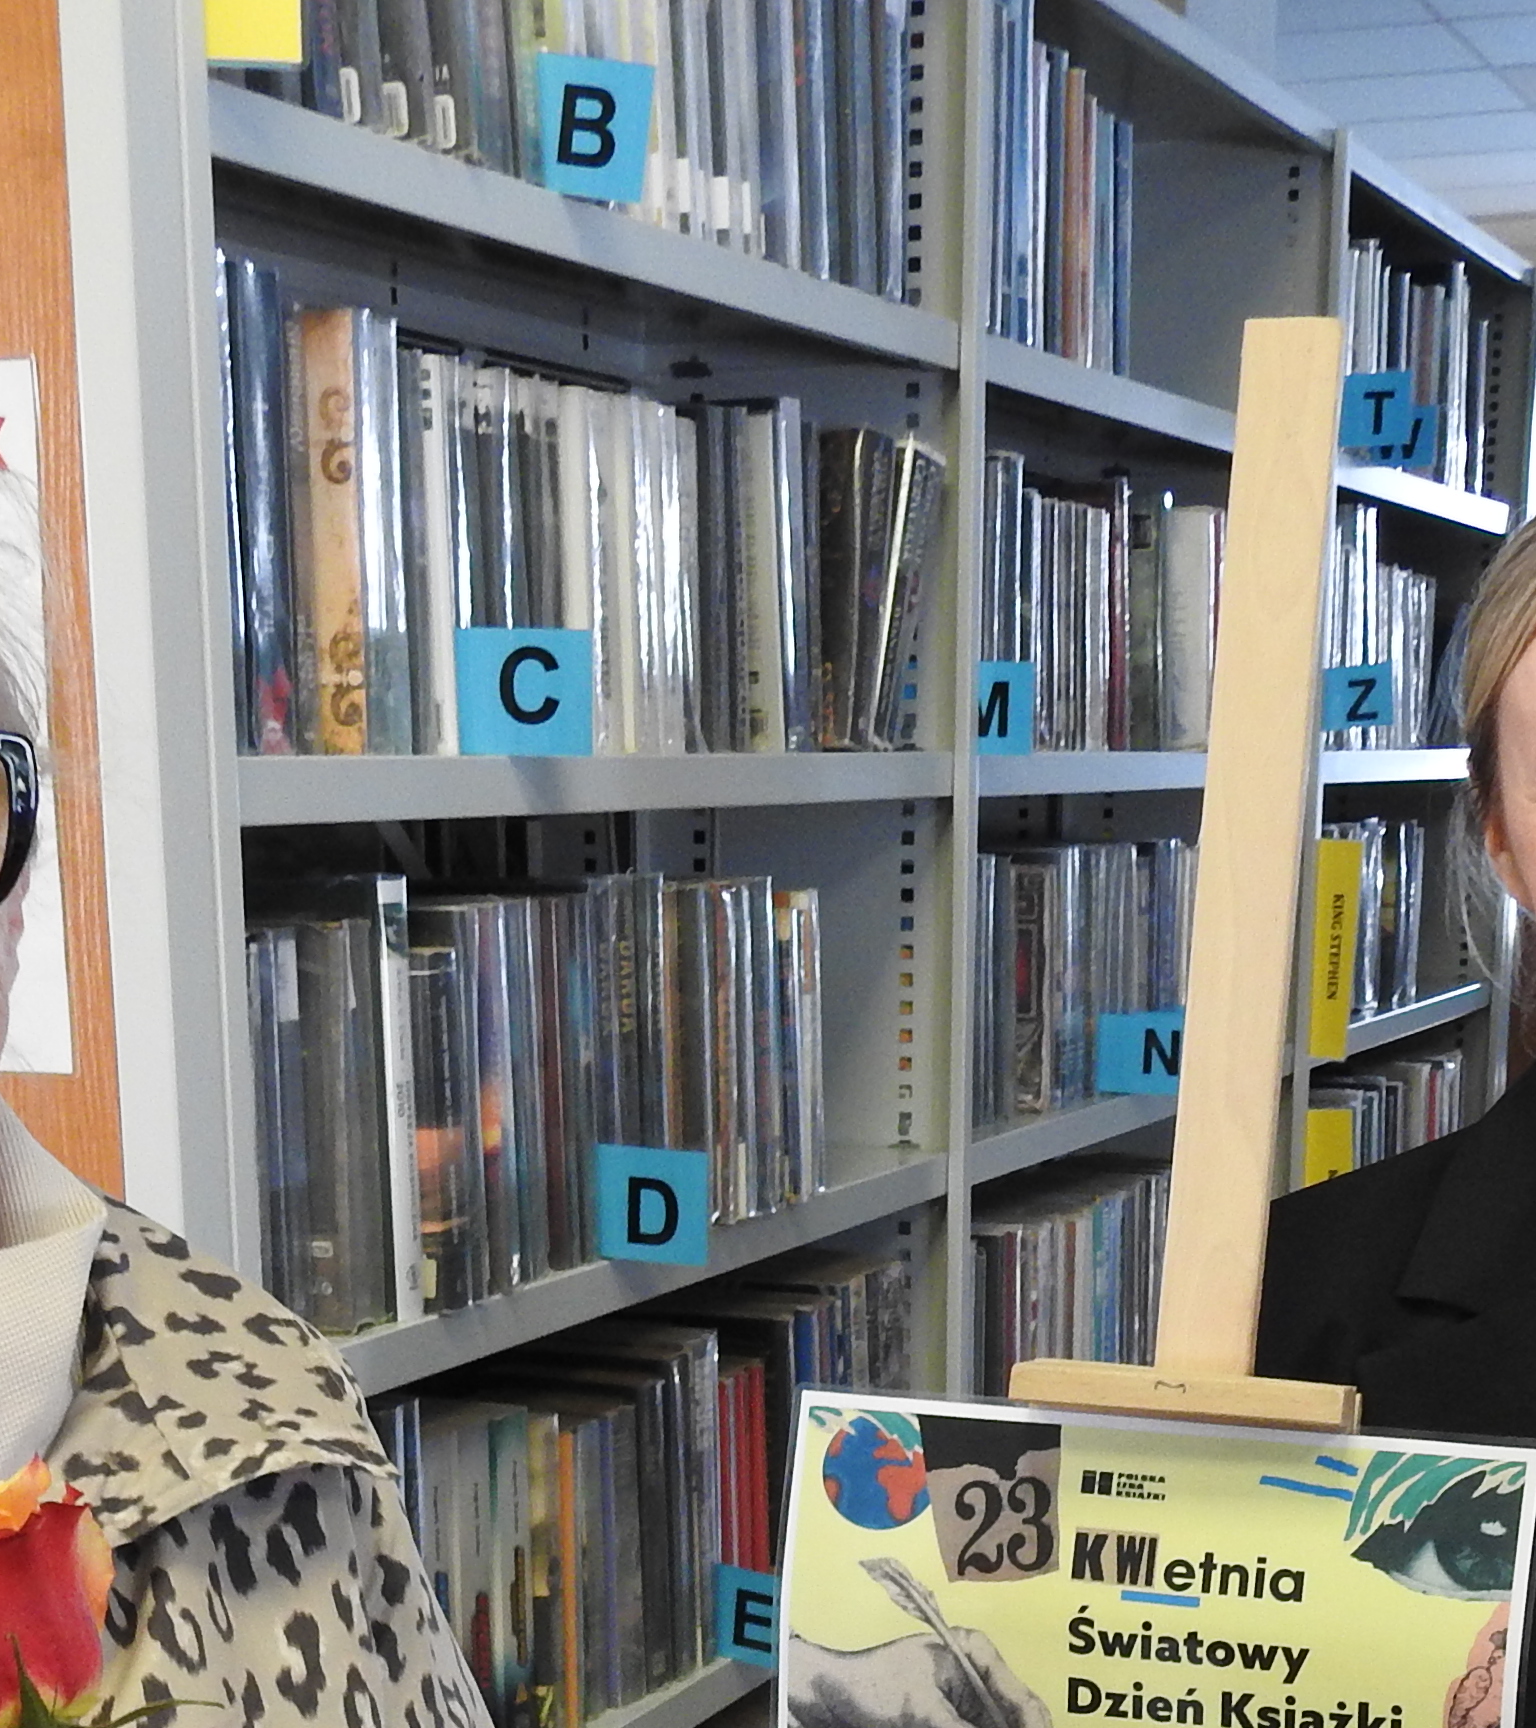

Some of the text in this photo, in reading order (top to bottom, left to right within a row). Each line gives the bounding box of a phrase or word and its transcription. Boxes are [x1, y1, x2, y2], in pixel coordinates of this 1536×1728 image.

[555, 83, 617, 170] B
[1364, 391, 1395, 436] T
[498, 646, 560, 725] C
[1347, 679, 1378, 722] Z
[1325, 893, 1346, 1002] KING STEPHEN
[1142, 1028, 1180, 1076] N
[625, 1175, 680, 1247] D
[954, 1474, 1054, 1576] 23
[734, 1589, 771, 1650] E
[1068, 1605, 1310, 1685] Światowy
[1067, 1676, 1204, 1727] Dzień
